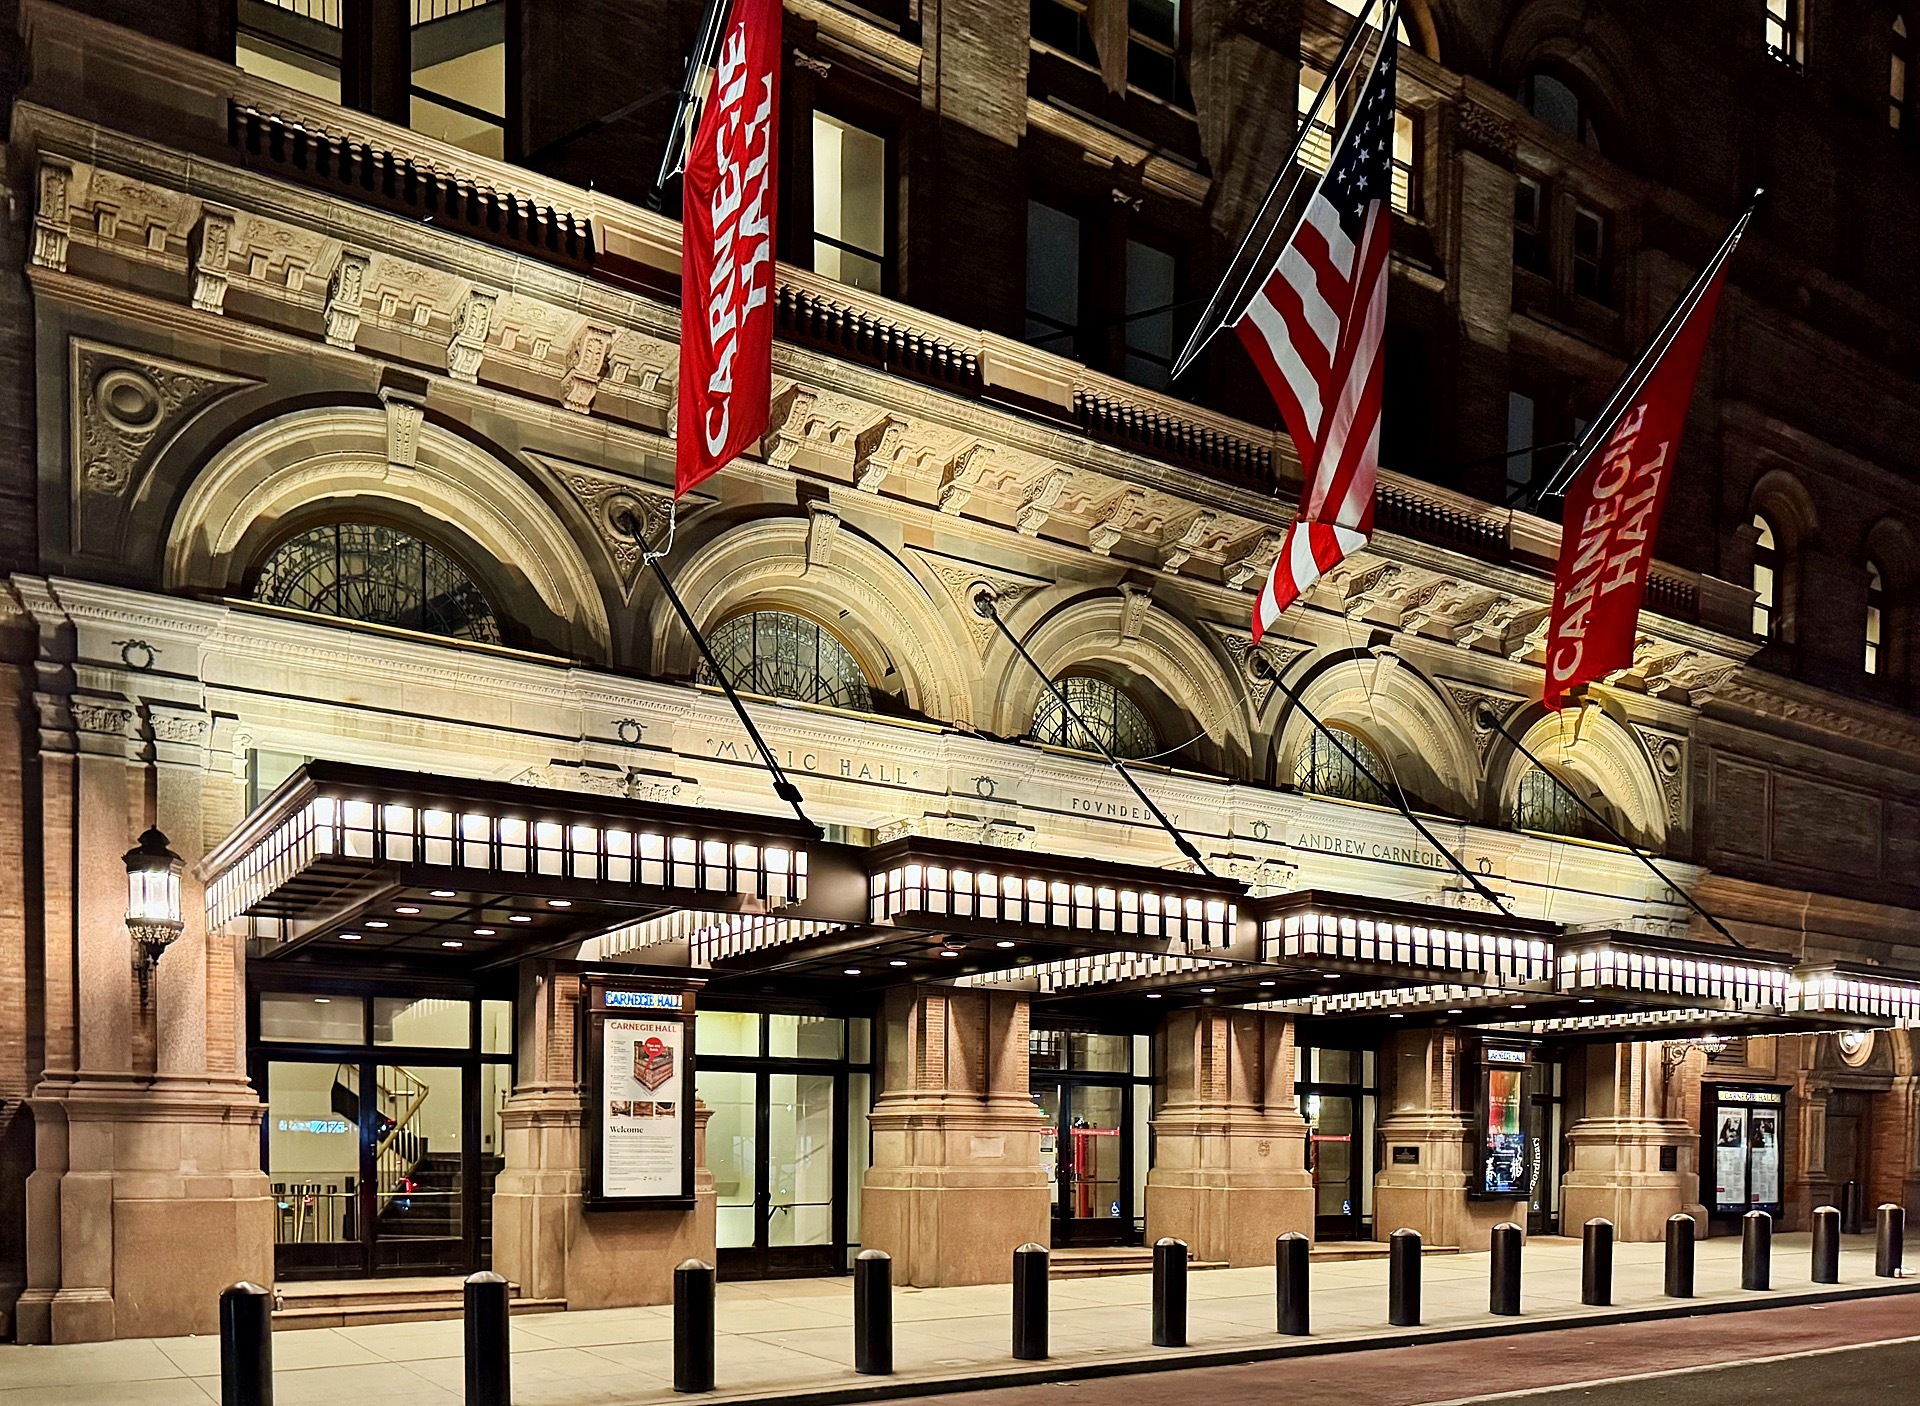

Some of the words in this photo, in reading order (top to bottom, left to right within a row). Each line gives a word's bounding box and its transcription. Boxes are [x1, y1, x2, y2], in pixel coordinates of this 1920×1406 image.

[739, 72, 772, 328] HALL
[706, 21, 747, 457] CARNEGIE
[1600, 441, 1669, 597] HALL
[1552, 403, 1648, 682] CARNEGIE
[839, 758, 908, 785] HALL
[1072, 797, 1151, 821] FOVNDED
[1297, 833, 1366, 855] ANDREW
[1371, 844, 1443, 868] CARNEGIE
[606, 992, 654, 1006] CARNEGIE
[657, 995, 682, 1008] HALL
[610, 1022, 653, 1031] CARNEGIE
[655, 1024, 677, 1033] HALL
[1724, 1092, 1756, 1101] CARNEGIE
[609, 1125, 644, 1134] Welcome
